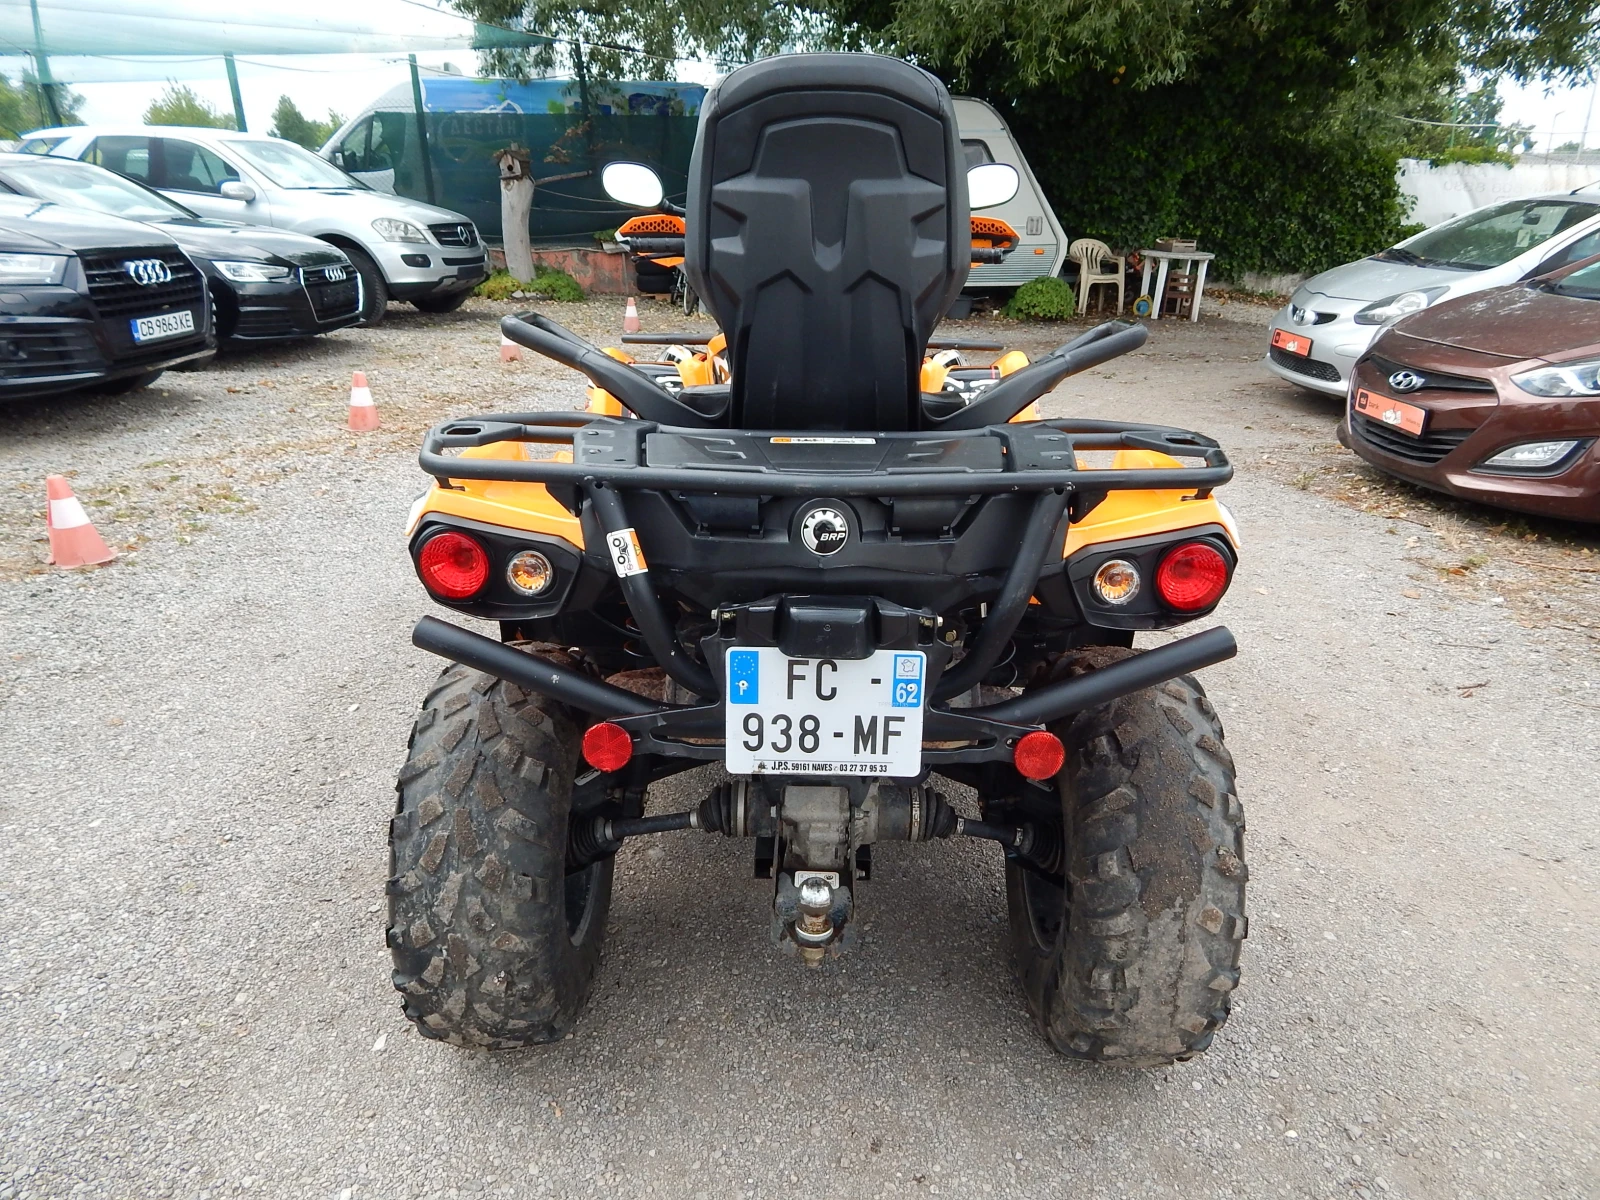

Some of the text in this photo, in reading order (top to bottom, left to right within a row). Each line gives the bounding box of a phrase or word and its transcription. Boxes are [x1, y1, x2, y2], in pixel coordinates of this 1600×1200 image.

[140, 313, 192, 337] CB 9863 KE
[820, 532, 846, 541] BRP
[786, 659, 838, 701] FC
[895, 682, 918, 704] 62
[771, 761, 790, 770] J.P.S.
[791, 763, 810, 771] 59161
[811, 763, 833, 772] NAVES
[839, 764, 848, 772] 03
[849, 764, 858, 772] 27
[859, 764, 867, 772] 37
[879, 765, 887, 773] 33
